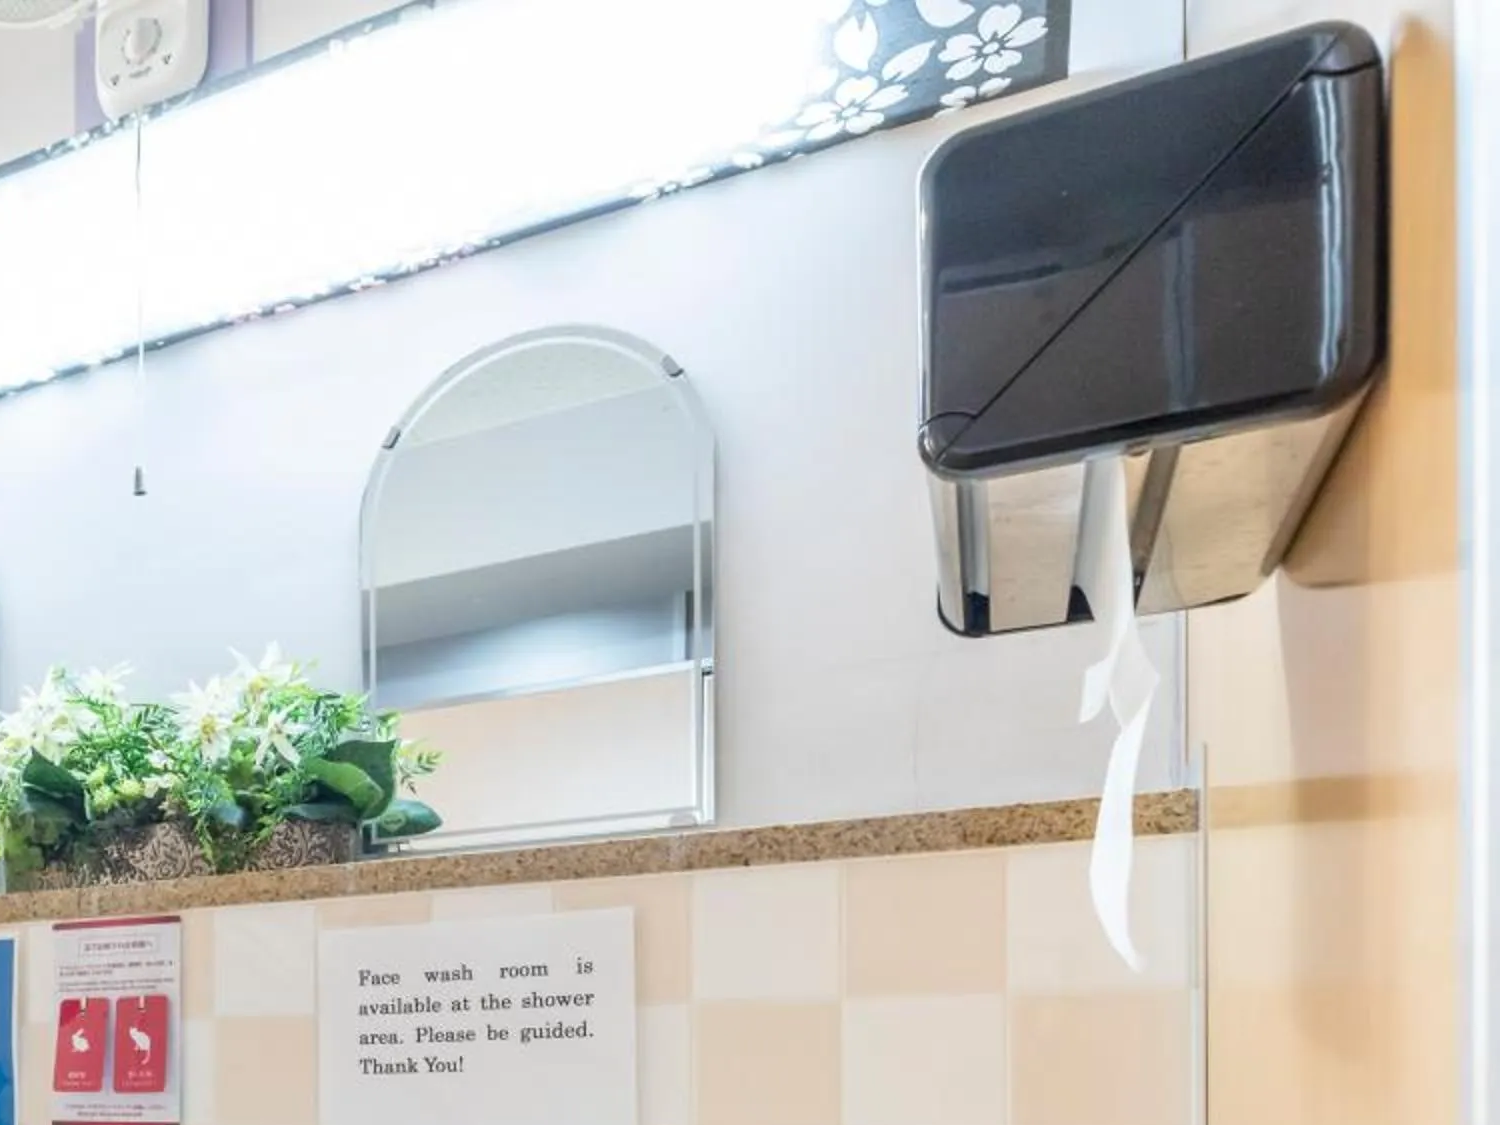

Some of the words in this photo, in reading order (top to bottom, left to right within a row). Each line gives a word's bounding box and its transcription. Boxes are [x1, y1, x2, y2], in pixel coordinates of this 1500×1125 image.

[358, 970, 401, 987] Face
[424, 963, 473, 983] wash
[499, 964, 549, 979] room
[576, 957, 594, 975] is
[358, 996, 442, 1016] available
[451, 997, 471, 1013] at
[480, 994, 513, 1011] the
[521, 991, 595, 1009] shower
[359, 1032, 404, 1046] area.
[415, 1027, 477, 1044] Please
[486, 1024, 510, 1041] be
[520, 1021, 595, 1044] guided.
[359, 1057, 419, 1075] Thank
[423, 1056, 464, 1073] You!
